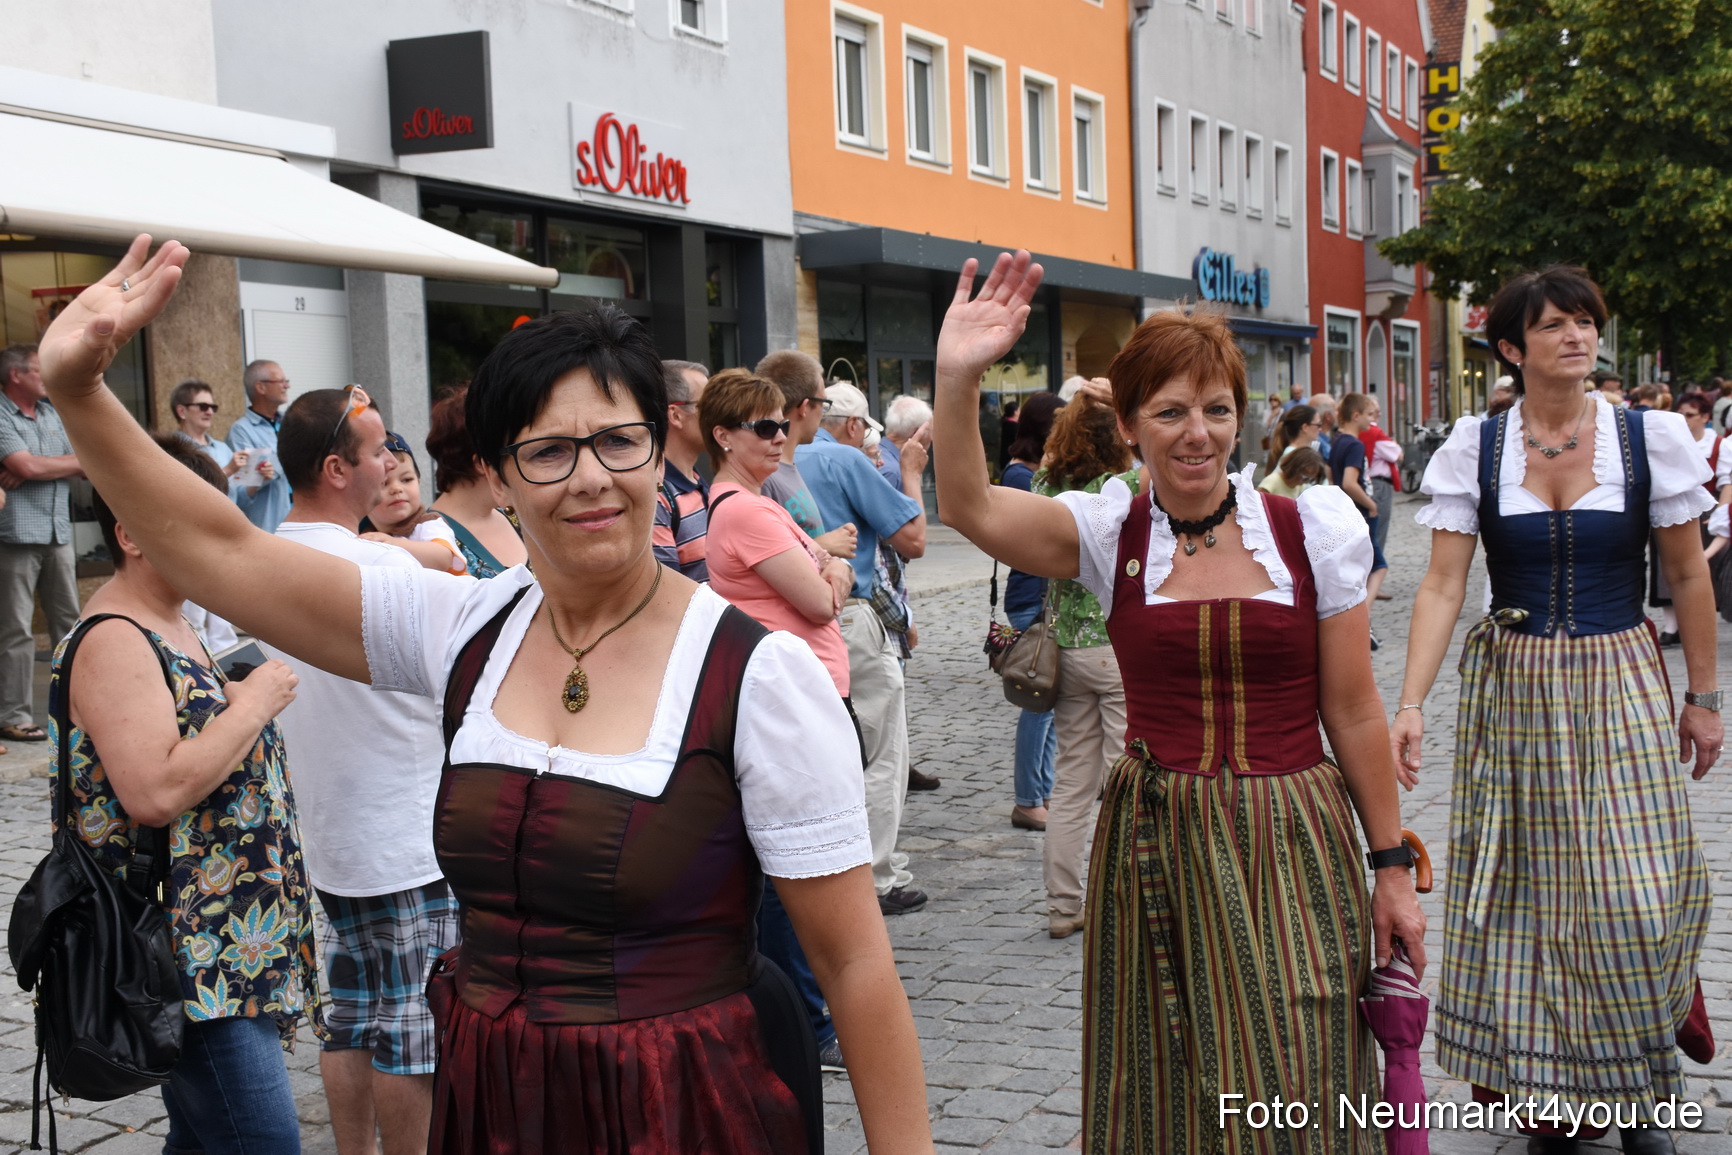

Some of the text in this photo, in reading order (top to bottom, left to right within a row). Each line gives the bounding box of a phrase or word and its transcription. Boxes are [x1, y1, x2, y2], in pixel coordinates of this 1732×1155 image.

[403, 107, 474, 139] s.Oliver
[576, 112, 691, 204] s.Oliver
[1196, 246, 1257, 305] Eilles
[295, 296, 305, 311] 29
